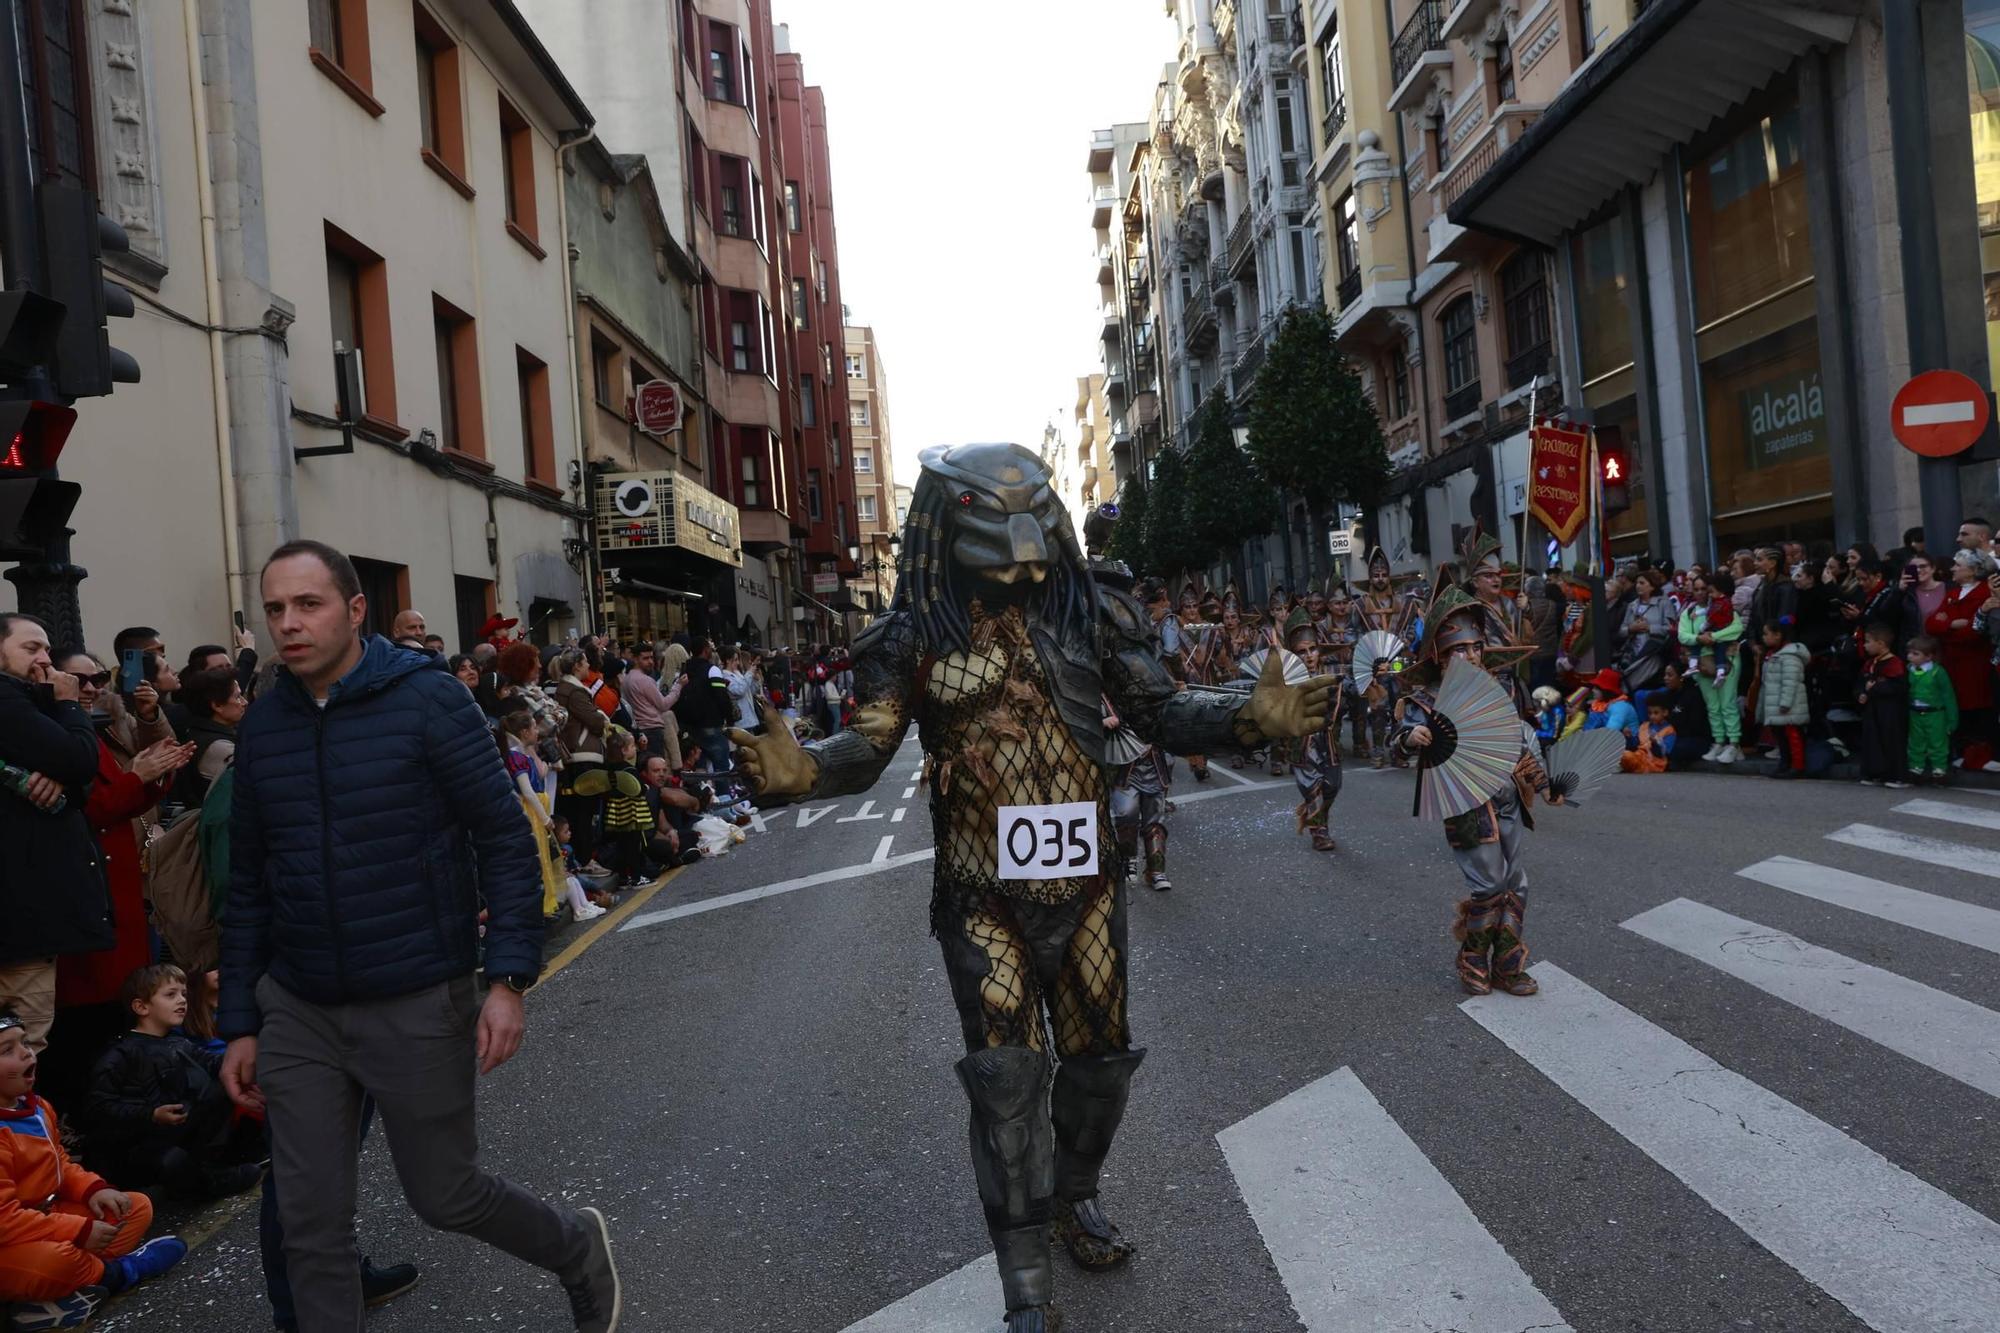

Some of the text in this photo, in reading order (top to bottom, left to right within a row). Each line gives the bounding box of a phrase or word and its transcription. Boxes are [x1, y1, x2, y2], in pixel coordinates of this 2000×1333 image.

[1752, 373, 1824, 435] alcalá
[1332, 539, 1349, 548] ORO
[1007, 817, 1091, 867] 035
